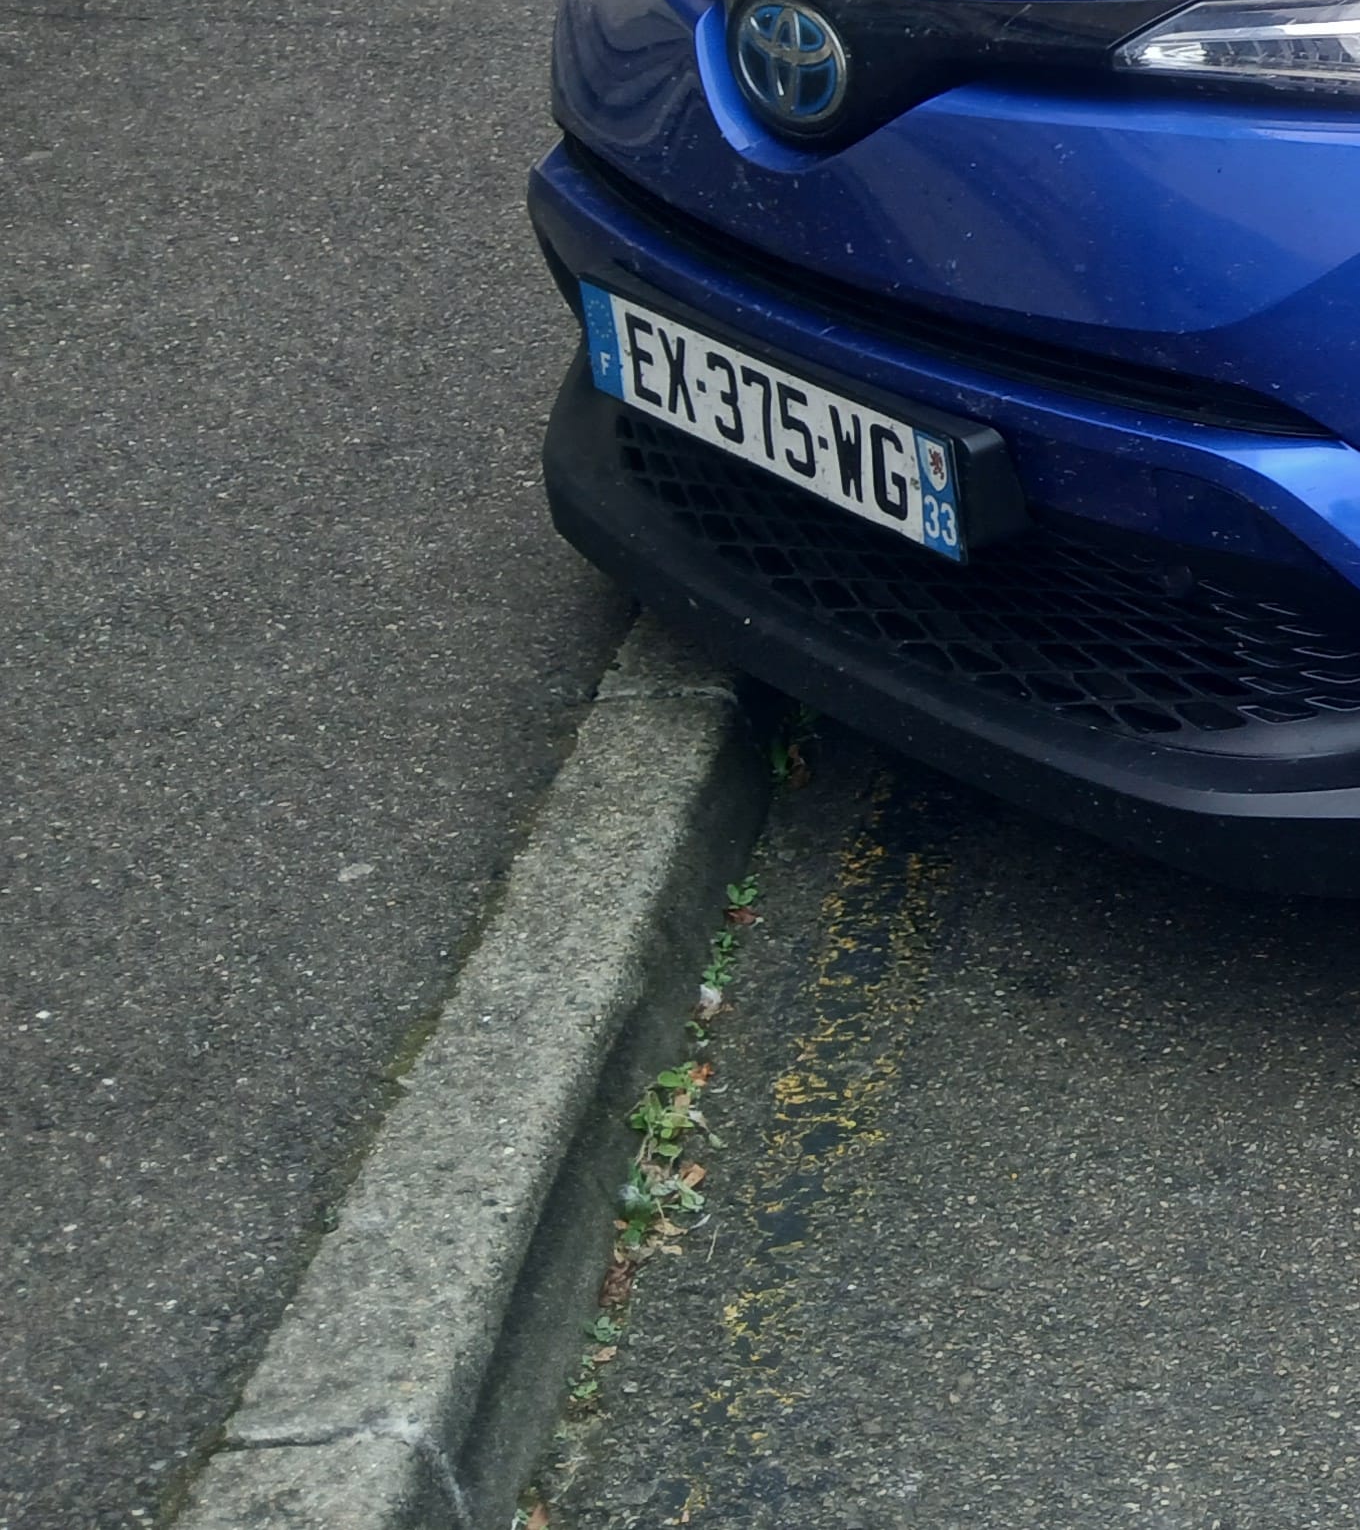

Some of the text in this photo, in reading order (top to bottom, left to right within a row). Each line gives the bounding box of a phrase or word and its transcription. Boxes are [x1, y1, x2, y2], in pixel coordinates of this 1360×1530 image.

[600, 312, 957, 549] F EX-375-WG 33
